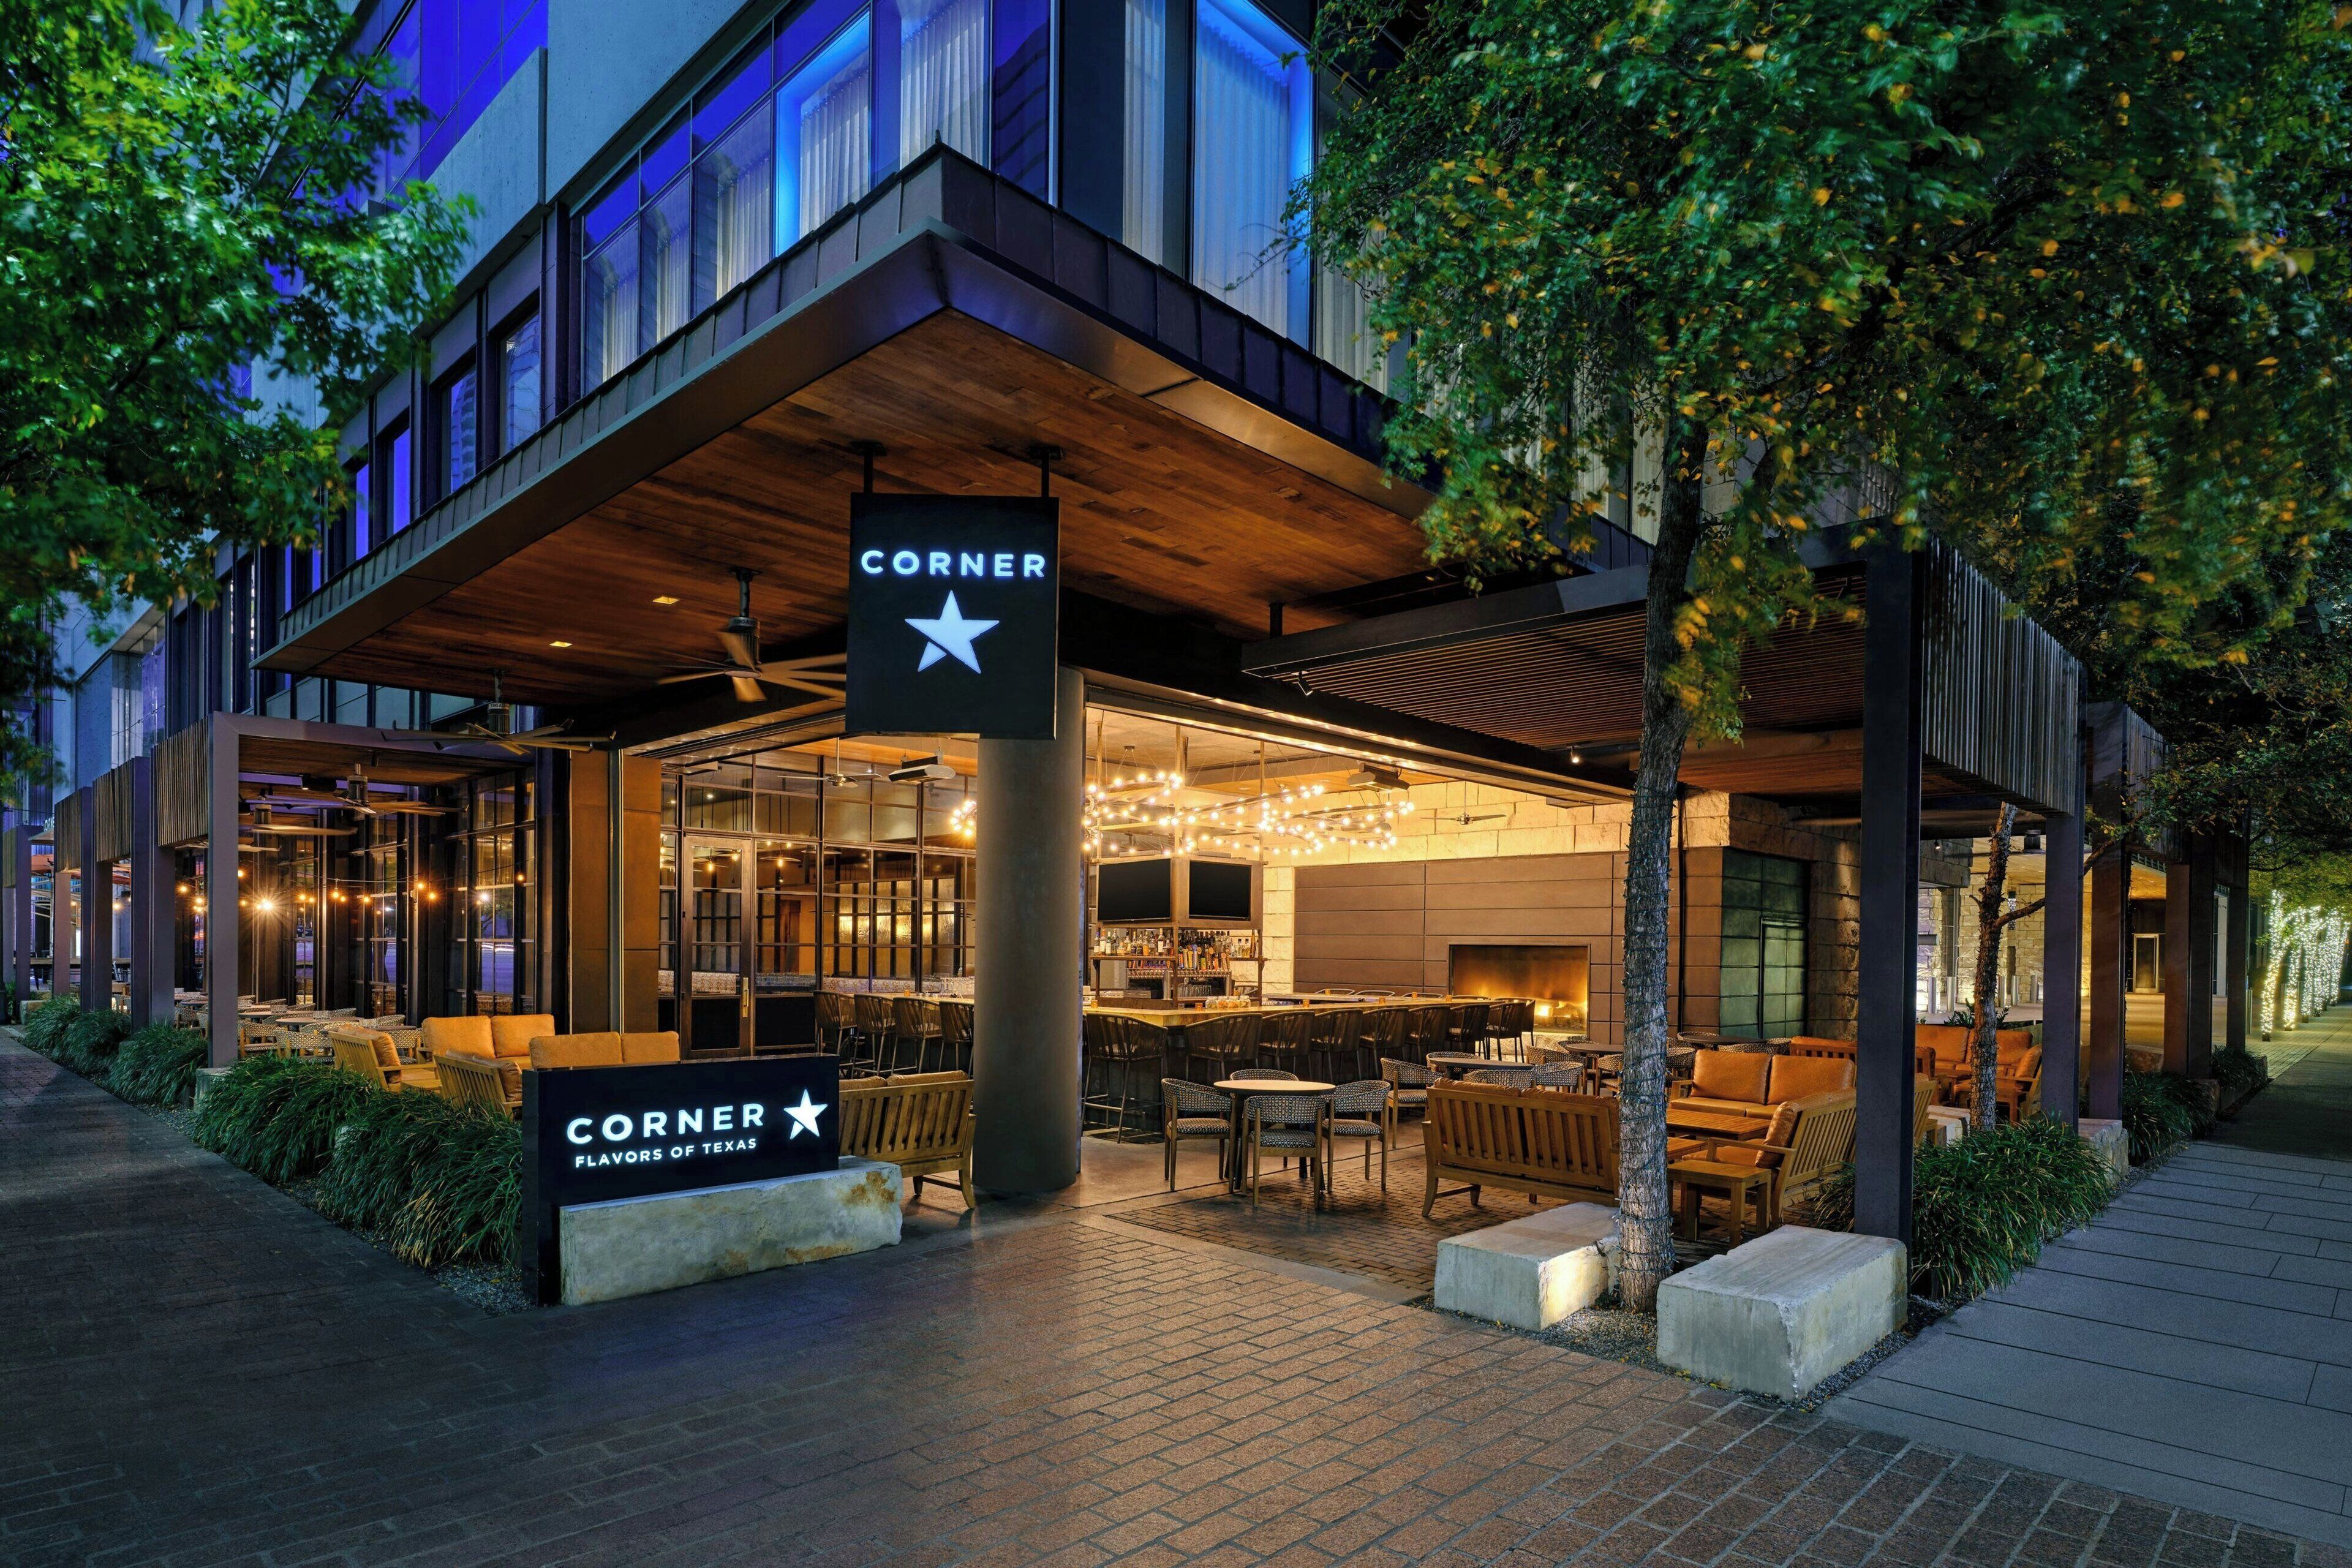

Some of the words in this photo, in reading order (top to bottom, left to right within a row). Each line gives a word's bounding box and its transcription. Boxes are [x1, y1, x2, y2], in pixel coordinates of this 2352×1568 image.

[861, 549, 1046, 578] CORNER
[566, 1102, 765, 1145] CORNER
[575, 1148, 663, 1169] FLAVORS
[670, 1145, 695, 1159] OF
[702, 1137, 757, 1155] TEXAS
